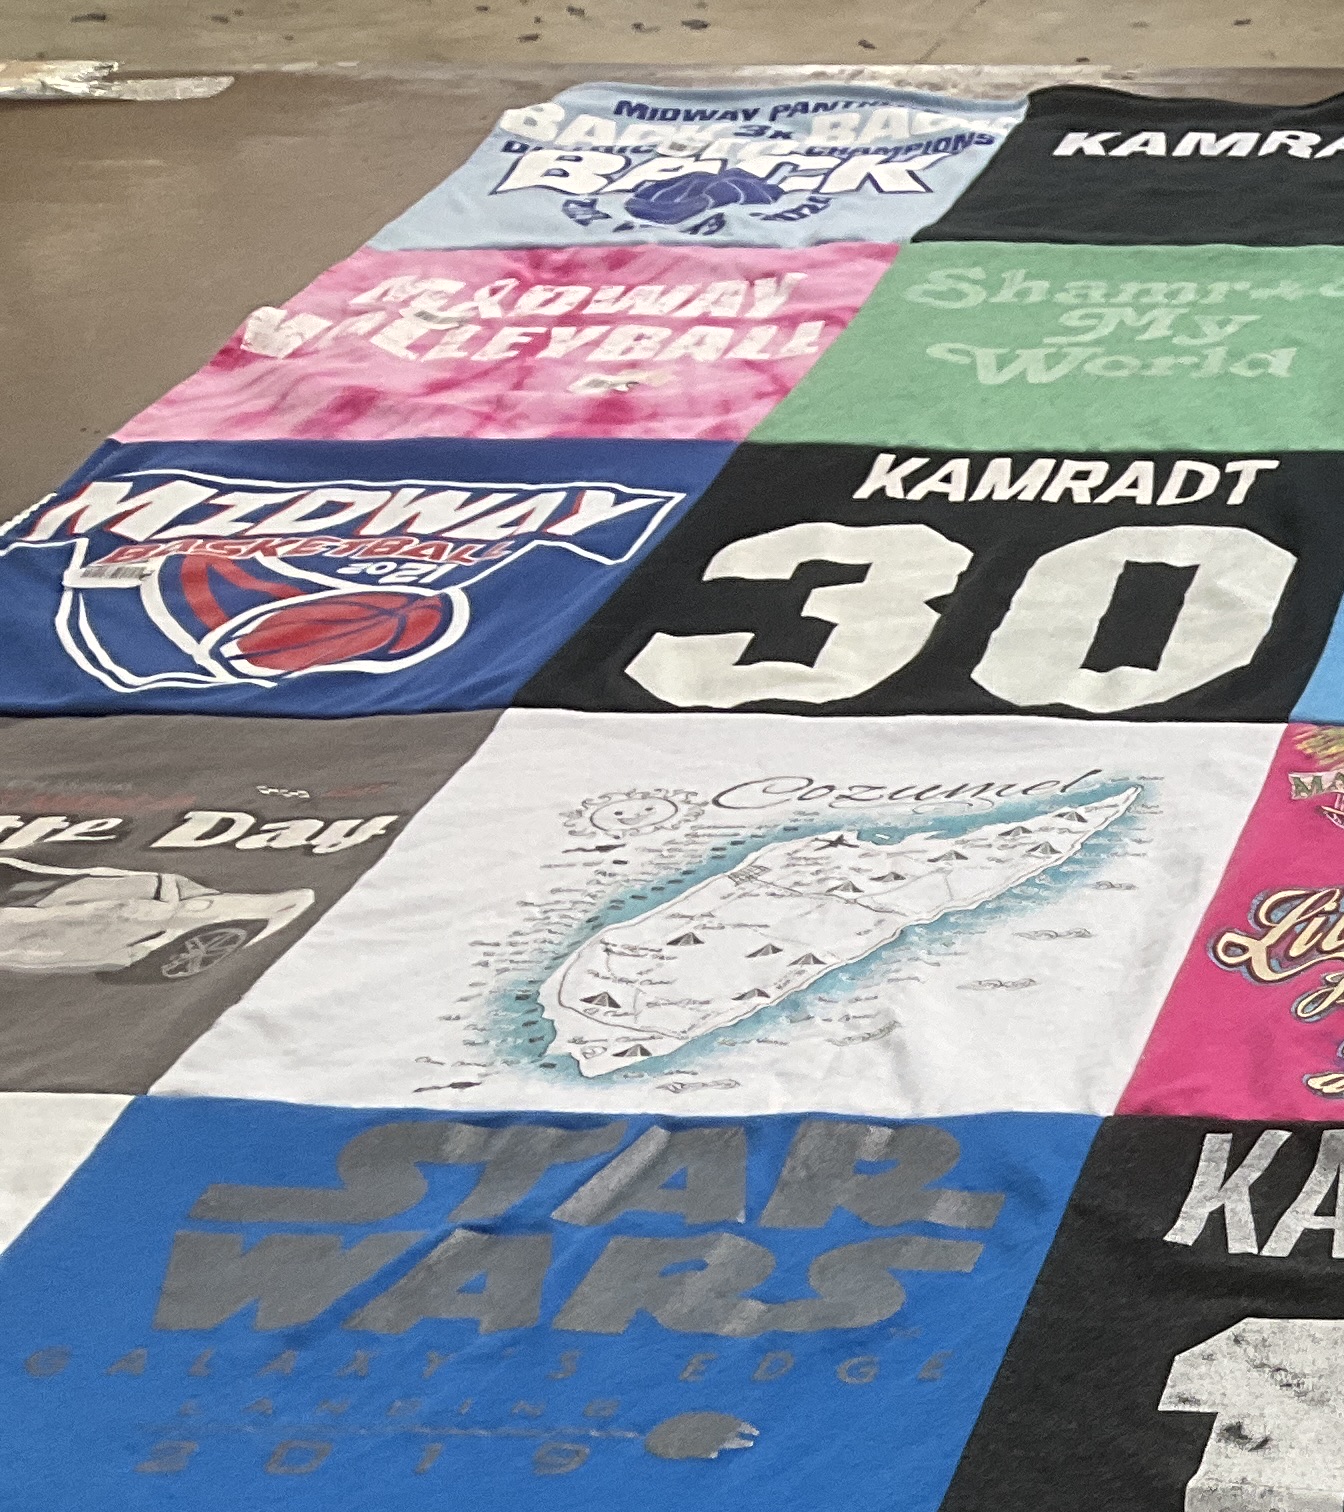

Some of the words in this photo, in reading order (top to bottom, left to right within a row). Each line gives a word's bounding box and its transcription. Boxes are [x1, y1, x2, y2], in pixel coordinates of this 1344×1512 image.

[613, 99, 760, 122] MIDWAY
[925, 341, 1299, 386] World
[853, 453, 1279, 506] KAMRADT
[27, 480, 672, 542] MIDWAY
[96, 534, 515, 567] BASKETBALL
[337, 562, 449, 584] 2021
[624, 521, 1298, 713] 30
[711, 767, 1102, 816] Cozumel
[149, 810, 400, 854] Day
[187, 1119, 1006, 1230] STAR
[152, 1225, 985, 1337] WARS
[677, 1349, 956, 1386] EDGE
